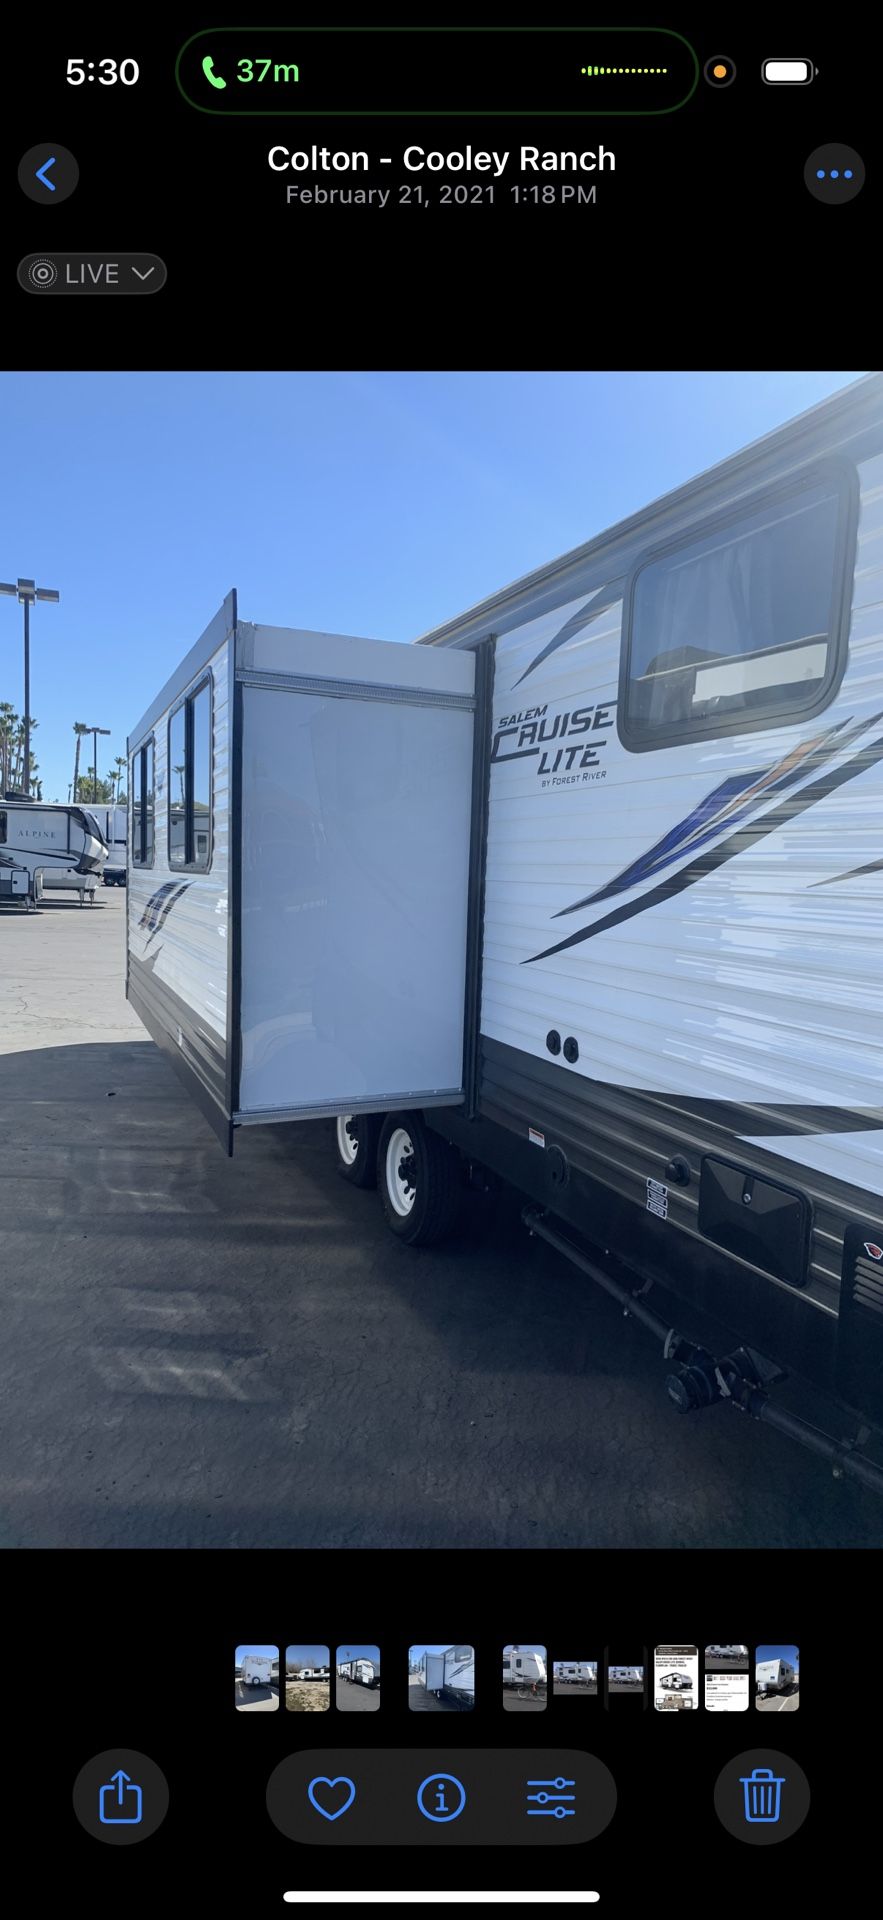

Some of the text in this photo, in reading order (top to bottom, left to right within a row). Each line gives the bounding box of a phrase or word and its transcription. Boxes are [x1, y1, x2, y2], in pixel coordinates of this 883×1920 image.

[498, 704, 548, 728] SALEM
[490, 700, 618, 763] CRUISE
[537, 740, 607, 774] LITE
[541, 770, 607, 788] BY FOREST RIVER
[18, 829, 56, 839] ALPINE
